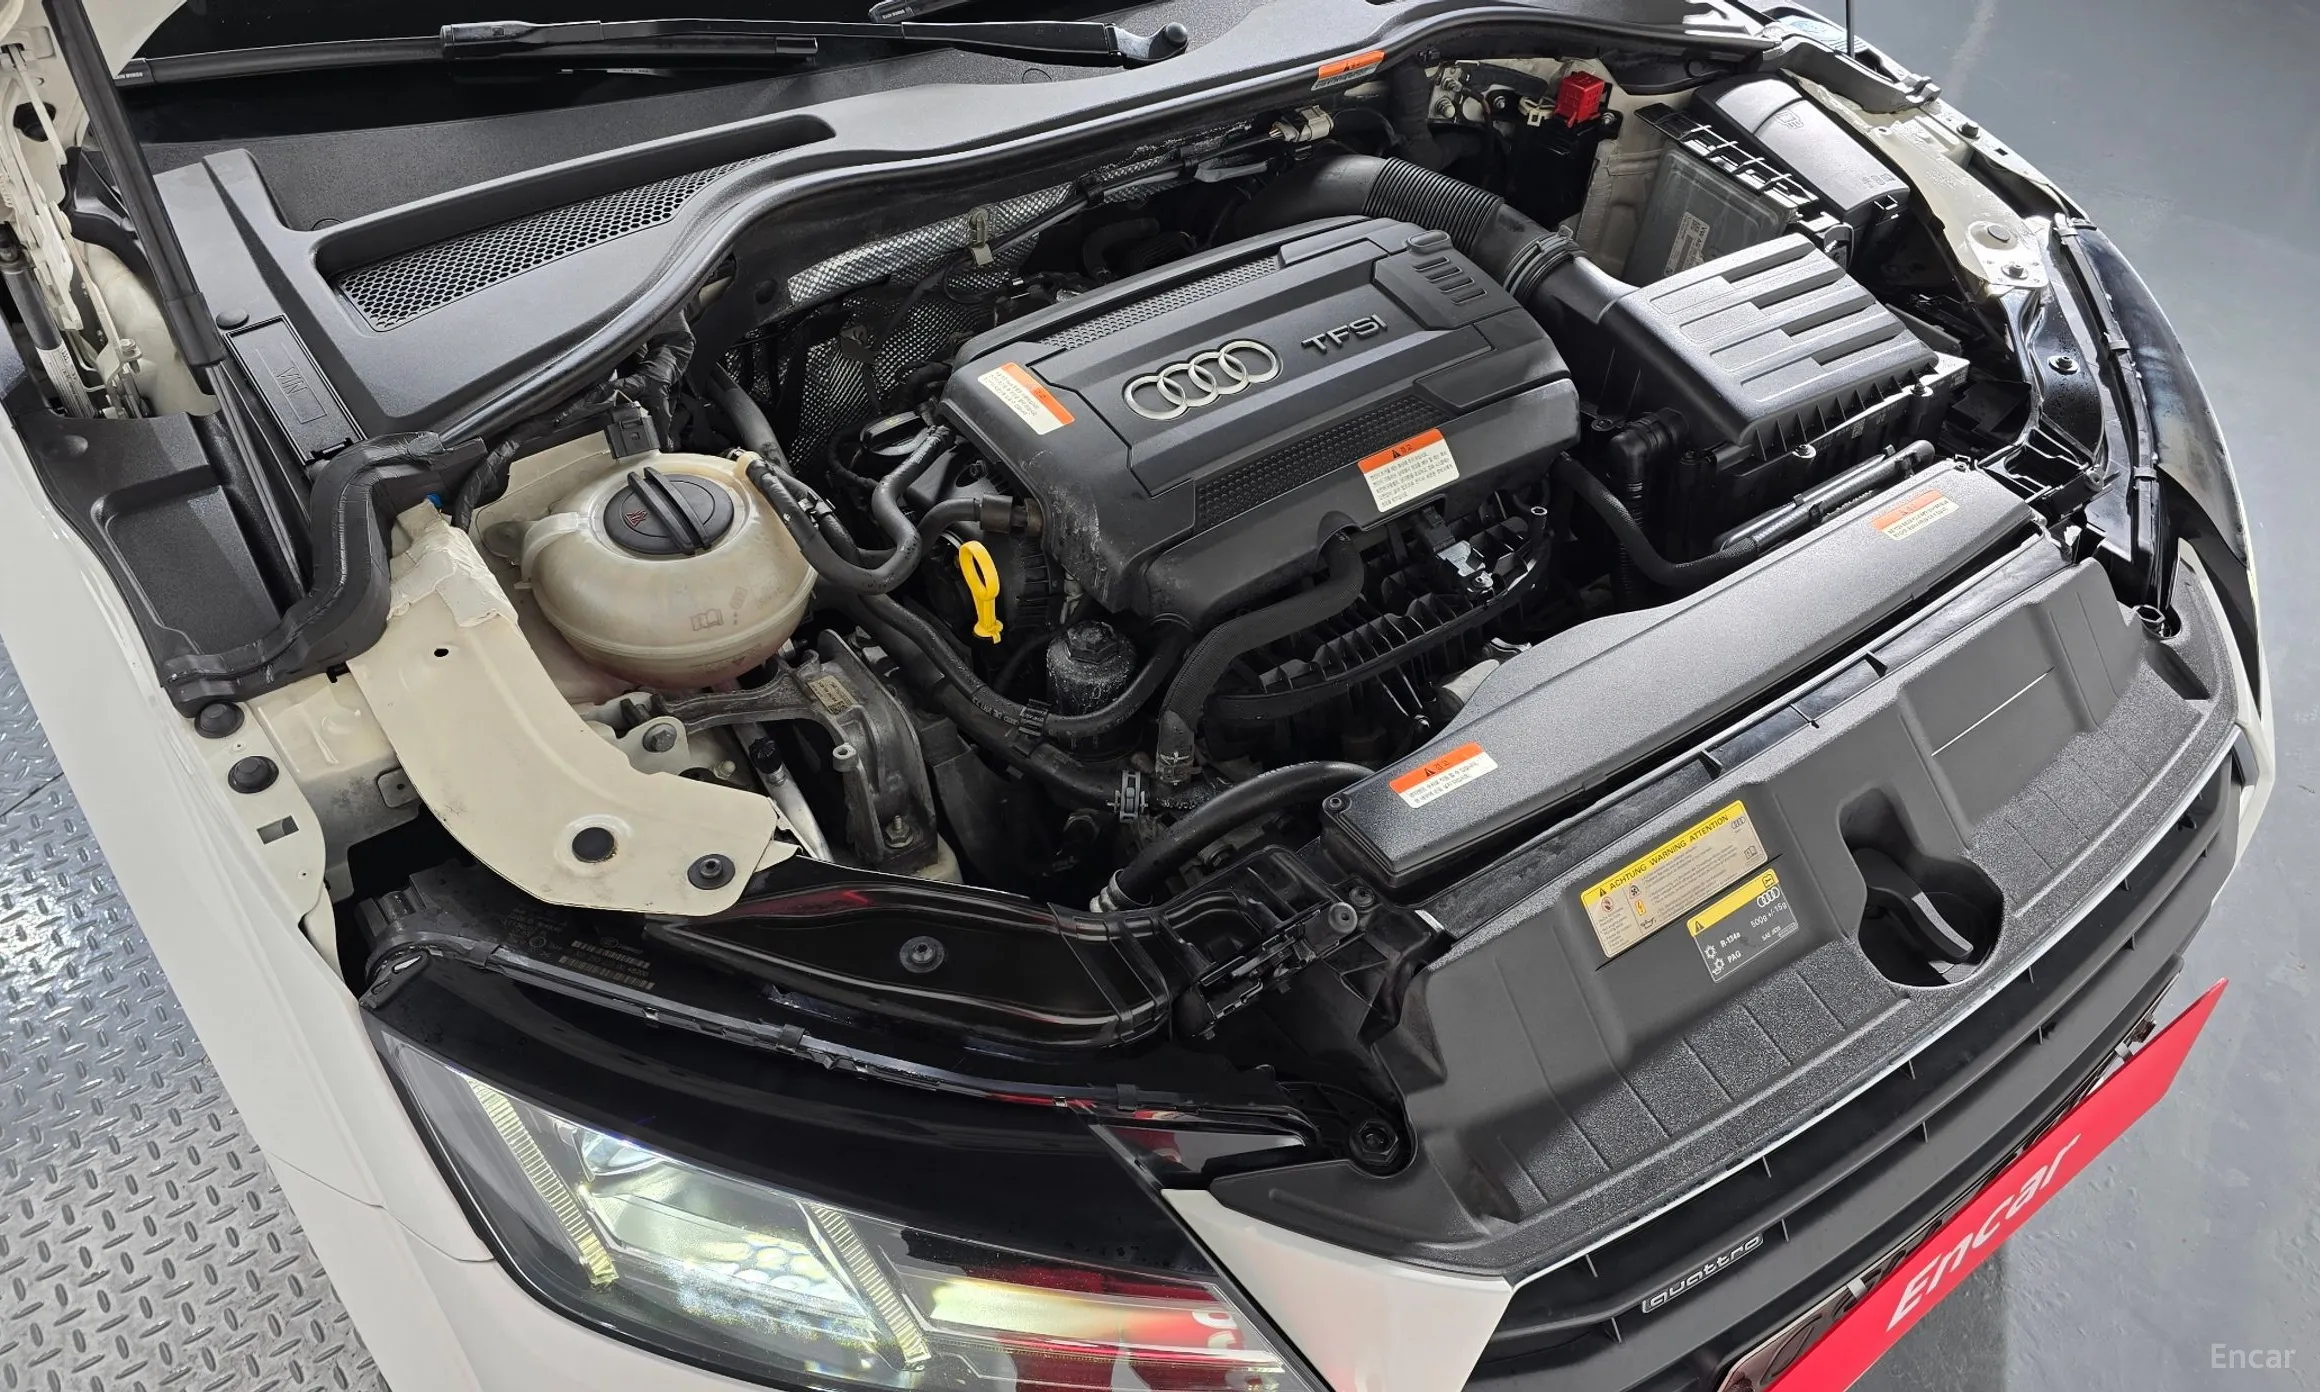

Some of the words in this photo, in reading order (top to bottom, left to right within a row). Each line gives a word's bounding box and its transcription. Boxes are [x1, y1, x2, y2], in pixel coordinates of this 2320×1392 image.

[1301, 313, 1388, 354] TFSI
[276, 366, 308, 395] VIN
[1609, 863, 1647, 891] ACHTUNG
[1649, 839, 1687, 866] WARNING
[1689, 814, 1729, 842] ATTENTION
[1750, 915, 1768, 928] 500g
[1719, 932, 1741, 948] R-134a
[1727, 950, 1742, 963] PAG
[1886, 1132, 2082, 1332] Encar
[1649, 1235, 1760, 1307] quattro
